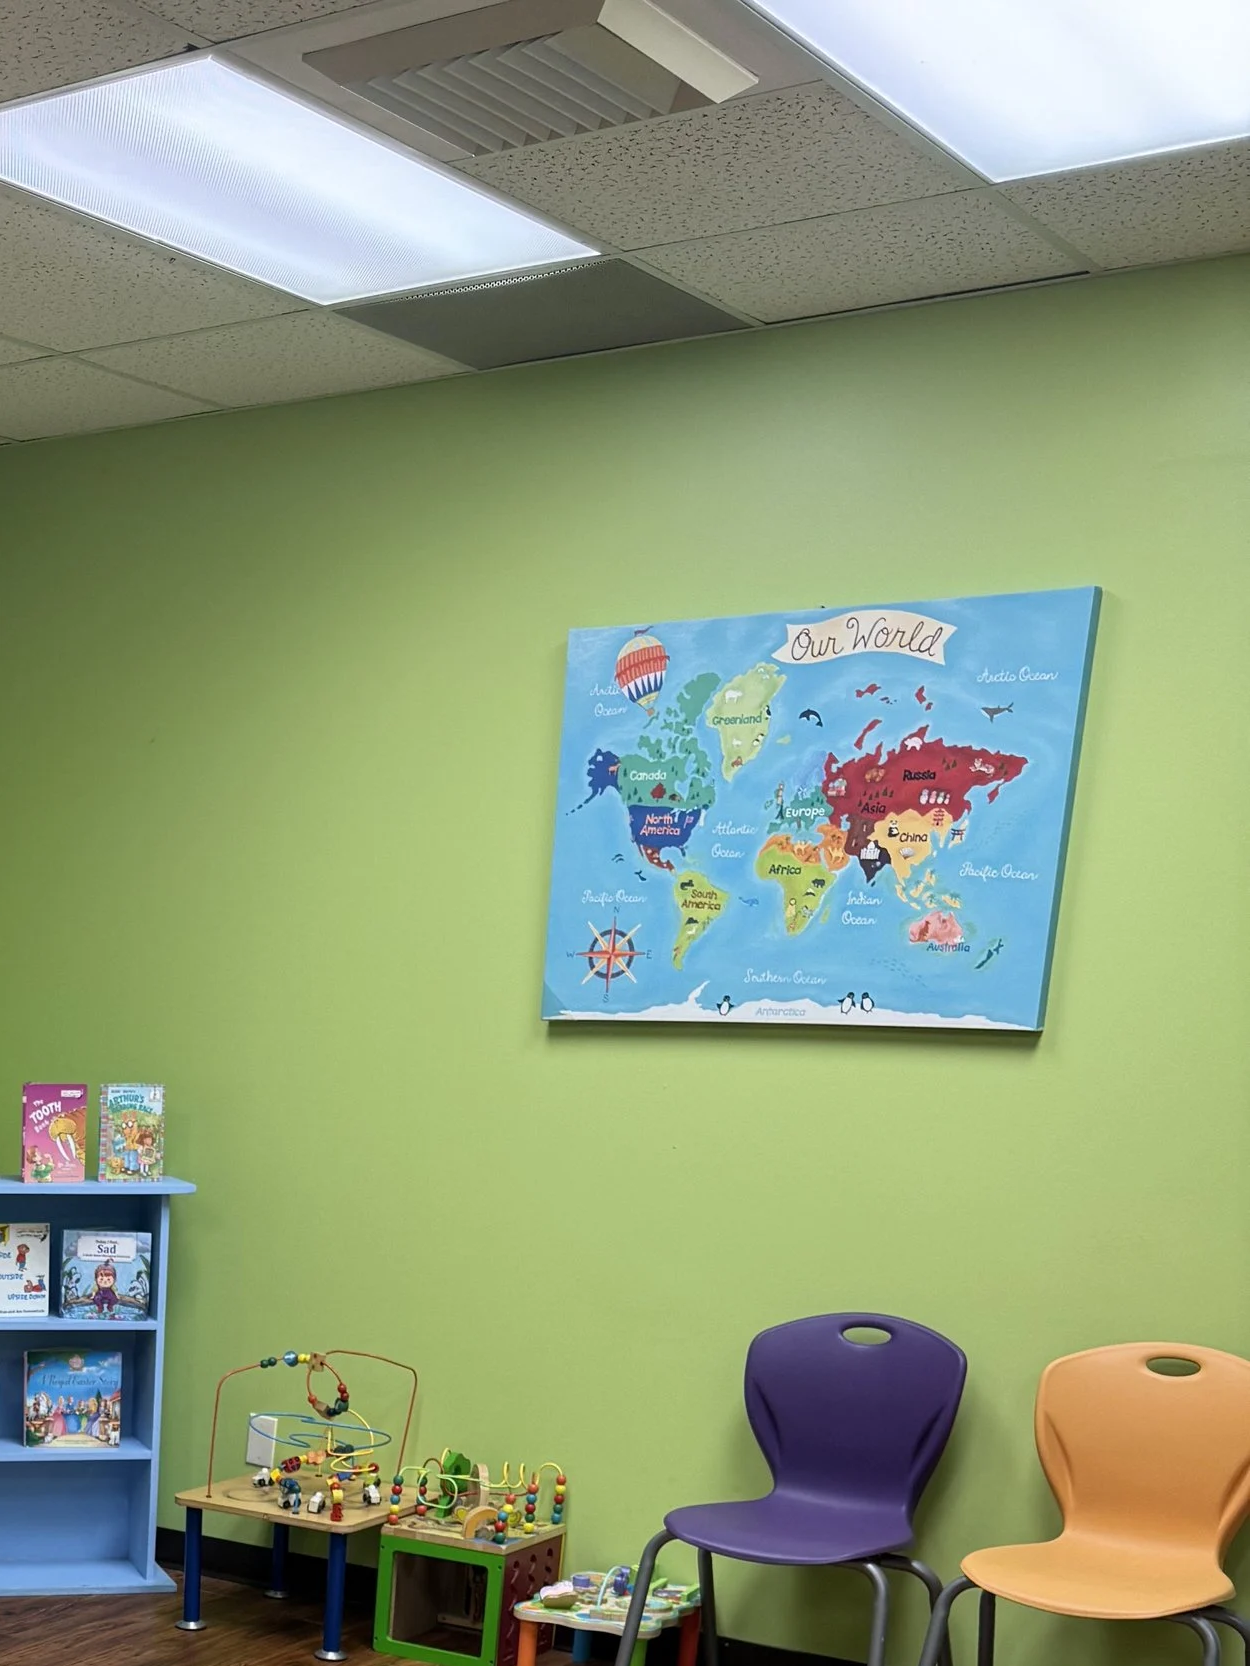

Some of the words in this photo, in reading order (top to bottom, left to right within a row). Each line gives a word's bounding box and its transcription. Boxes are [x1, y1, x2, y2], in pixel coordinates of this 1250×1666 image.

[791, 628, 844, 661] Our
[846, 617, 944, 657] World
[976, 668, 1016, 683] Arctic
[1018, 666, 1058, 681] Ocean
[594, 703, 628, 717] Ocean
[712, 712, 762, 725] Greenland
[630, 770, 667, 781] Canada
[903, 770, 936, 782] Russia
[785, 806, 825, 821] Europe
[861, 802, 886, 814] Asia
[645, 813, 673, 825] North
[640, 824, 680, 836] America
[712, 821, 757, 835] Atlantic
[899, 832, 928, 843] China
[711, 844, 745, 859] Ocean
[768, 864, 802, 875] Africa
[959, 862, 1000, 881] Pacific
[1001, 864, 1038, 880] Ocean
[581, 889, 614, 906] Pacific
[615, 889, 647, 903] Ocean
[691, 889, 718, 900] South
[846, 891, 882, 906] Indian
[681, 900, 721, 911] America
[841, 911, 877, 925] Ocean
[926, 941, 970, 953] Australia
[646, 949, 653, 959] E
[743, 967, 791, 984] Southern
[793, 970, 827, 985] Ocean
[602, 993, 609, 1003] S
[29, 1101, 62, 1124] TOOTH
[97, 1244, 117, 1254] Sad
